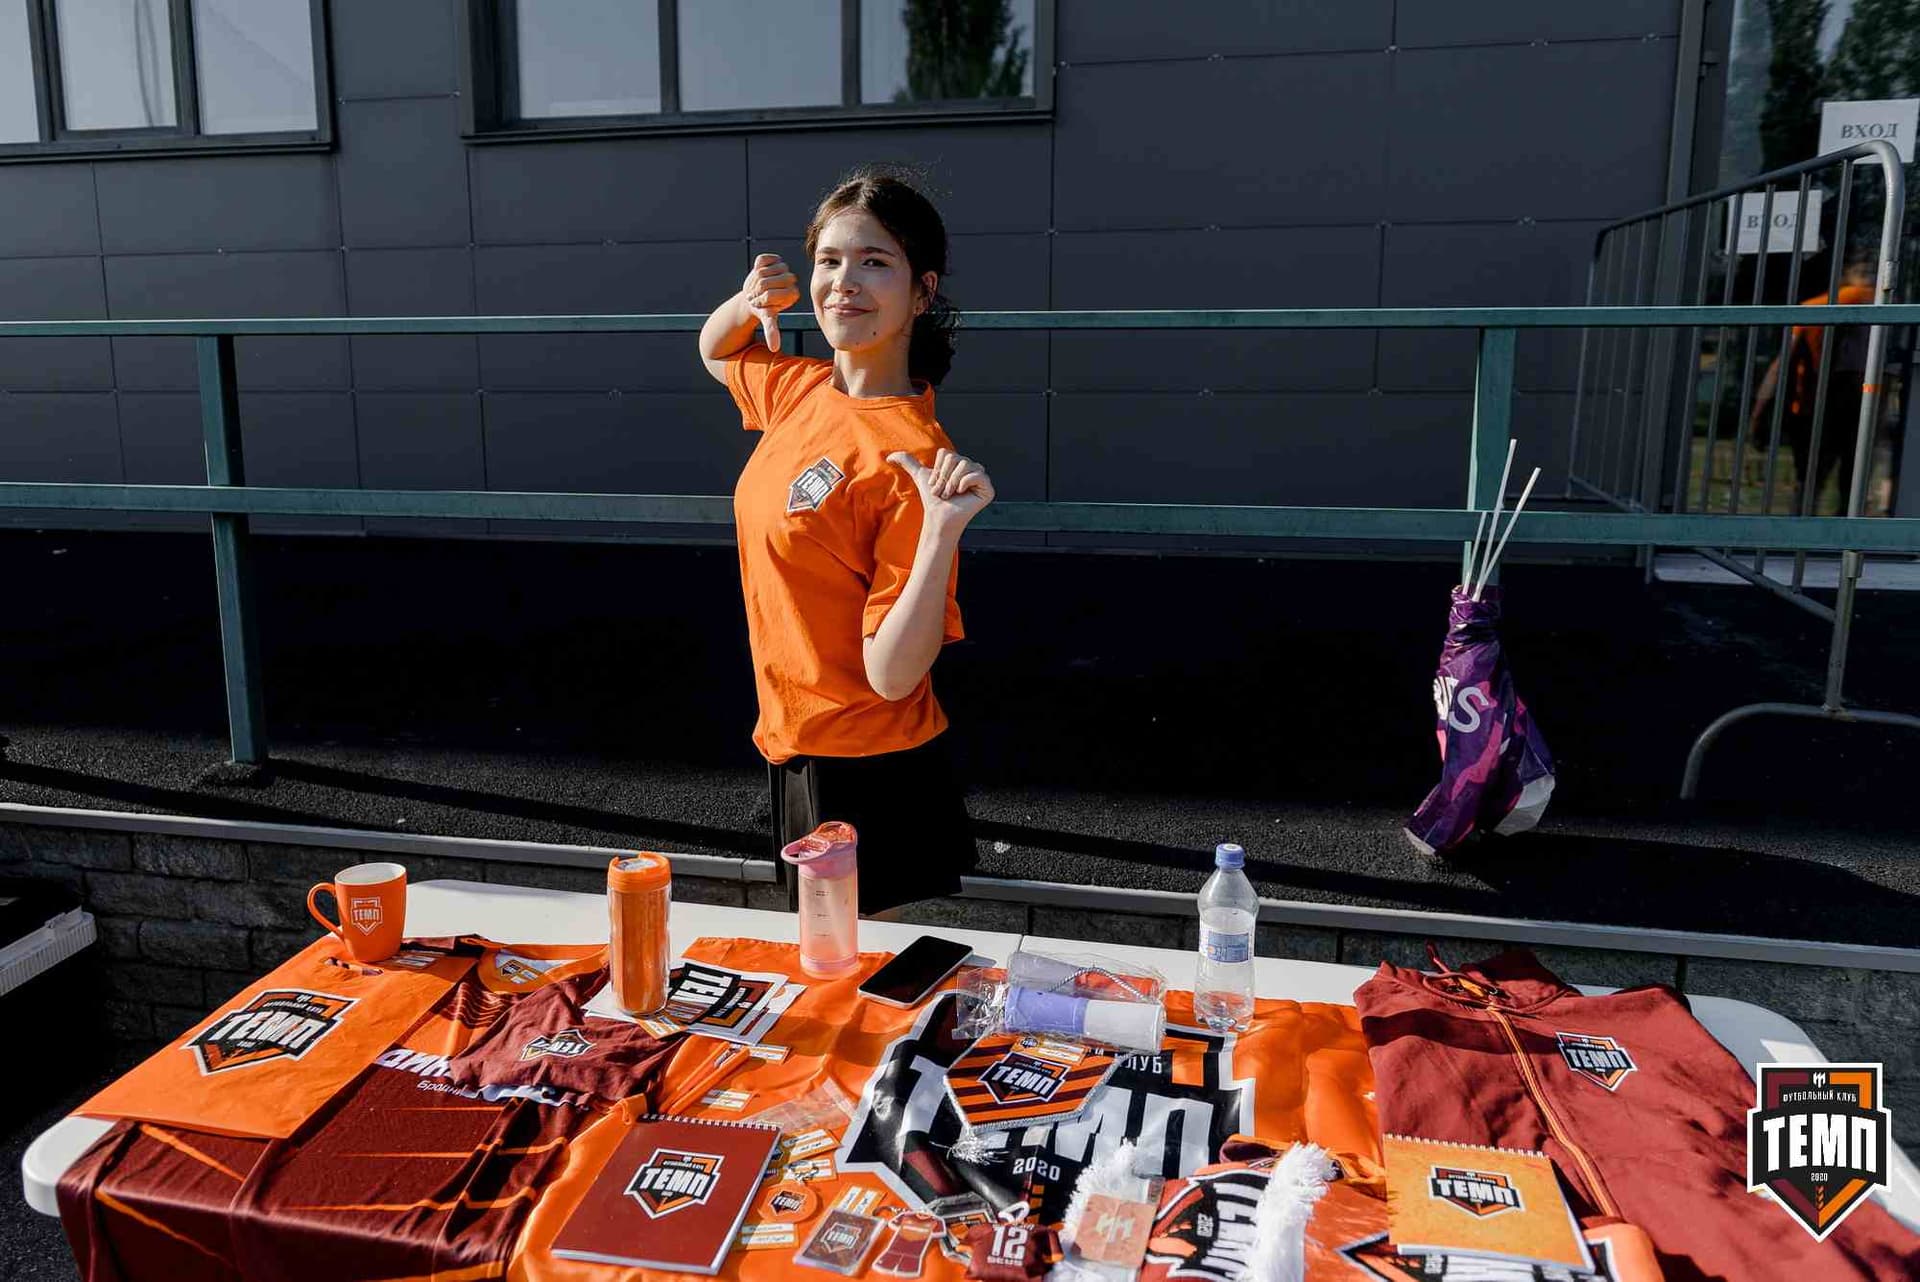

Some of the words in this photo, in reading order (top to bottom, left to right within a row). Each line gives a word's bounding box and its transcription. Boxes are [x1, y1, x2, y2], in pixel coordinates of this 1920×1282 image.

[1841, 123, 1898, 139] ВХОД
[1746, 213, 1799, 230] ВО
[353, 908, 380, 921] ТЕМП
[207, 1010, 327, 1050] ТЕМП
[1119, 1054, 1163, 1074] ЛУБ
[1566, 1048, 1628, 1068] ТЕМП
[991, 1065, 1055, 1095] ТЕМП
[1012, 1156, 1061, 1181] 2020
[639, 1167, 711, 1197] ТЕМП
[1436, 1178, 1515, 1205] ТЕМП
[774, 1195, 801, 1210] ТЕМП
[826, 1230, 855, 1246] ТЕМП
[991, 1224, 1028, 1261] 12
